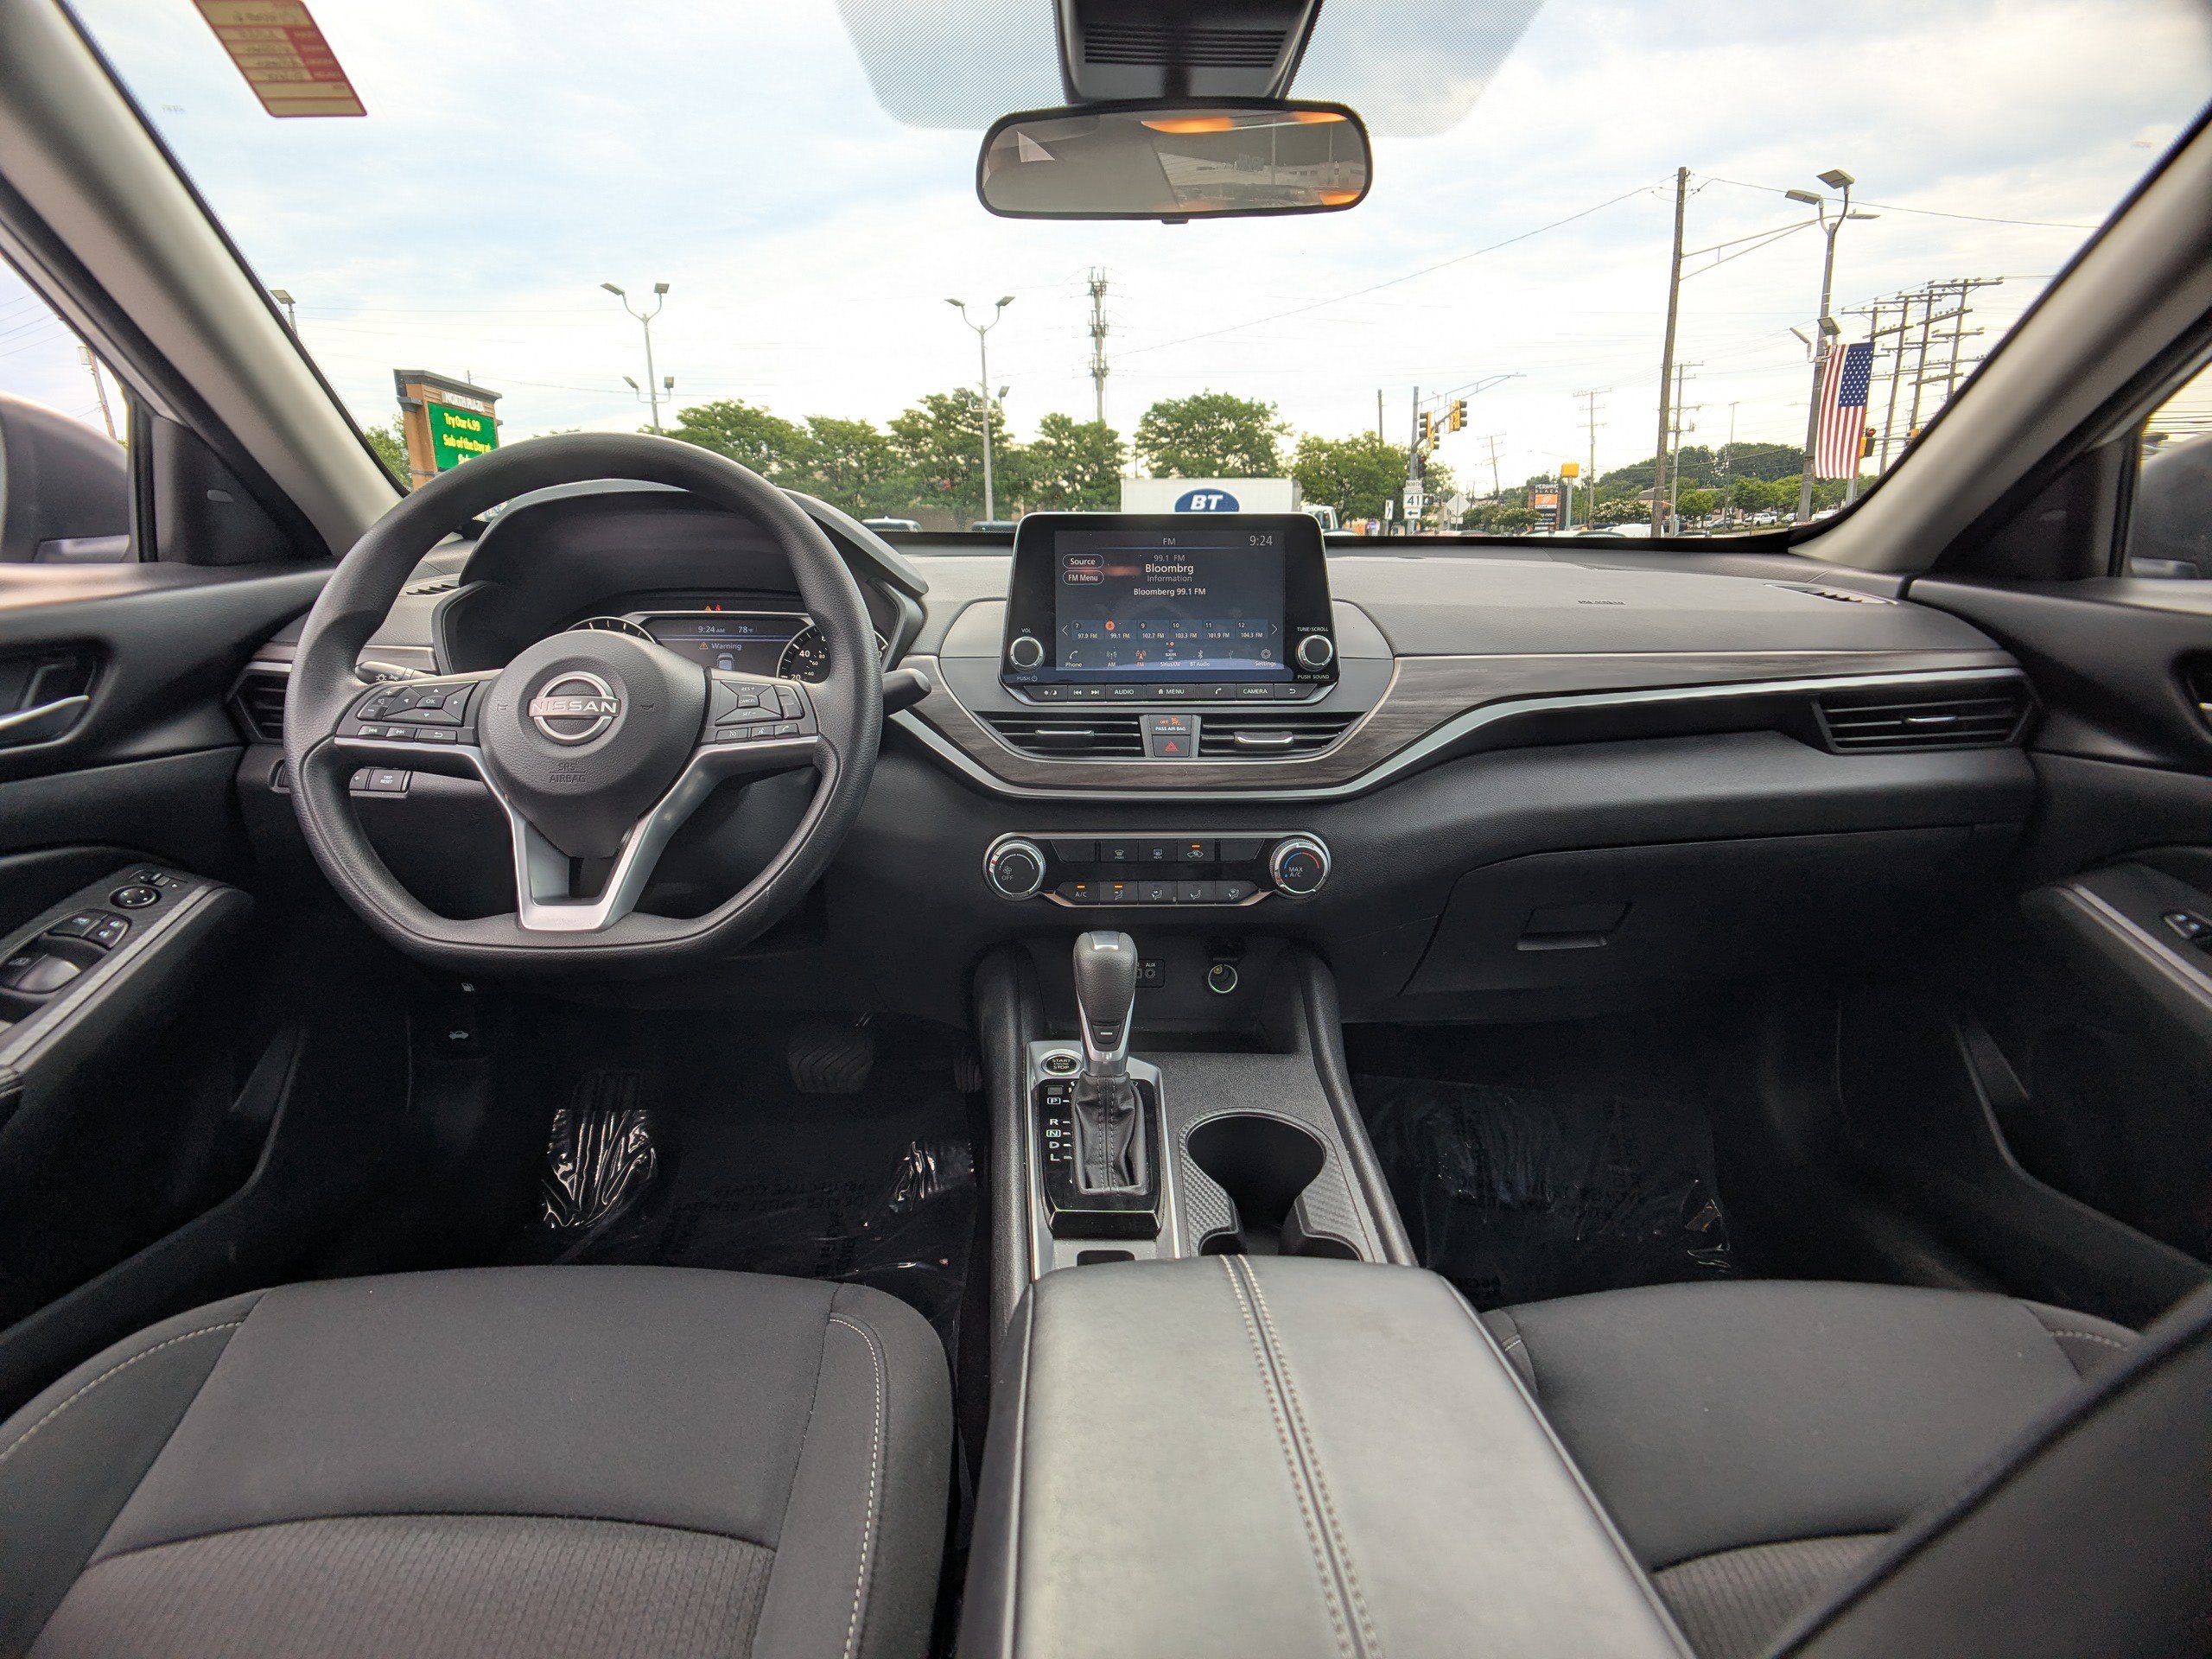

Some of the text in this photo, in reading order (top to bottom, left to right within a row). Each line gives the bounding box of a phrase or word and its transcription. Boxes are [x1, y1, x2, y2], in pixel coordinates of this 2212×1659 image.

[443, 412, 454, 428] Try
[1190, 494, 1223, 511] BT
[1407, 495, 1420, 505] 41
[1249, 535, 1273, 546] 9:24
[1145, 563, 1194, 575] Bloombrg
[1133, 588, 1175, 597] Bloomberg
[531, 700, 617, 714] NISSAN
[557, 763, 576, 772] SRS
[549, 774, 587, 783] AIRBAG
